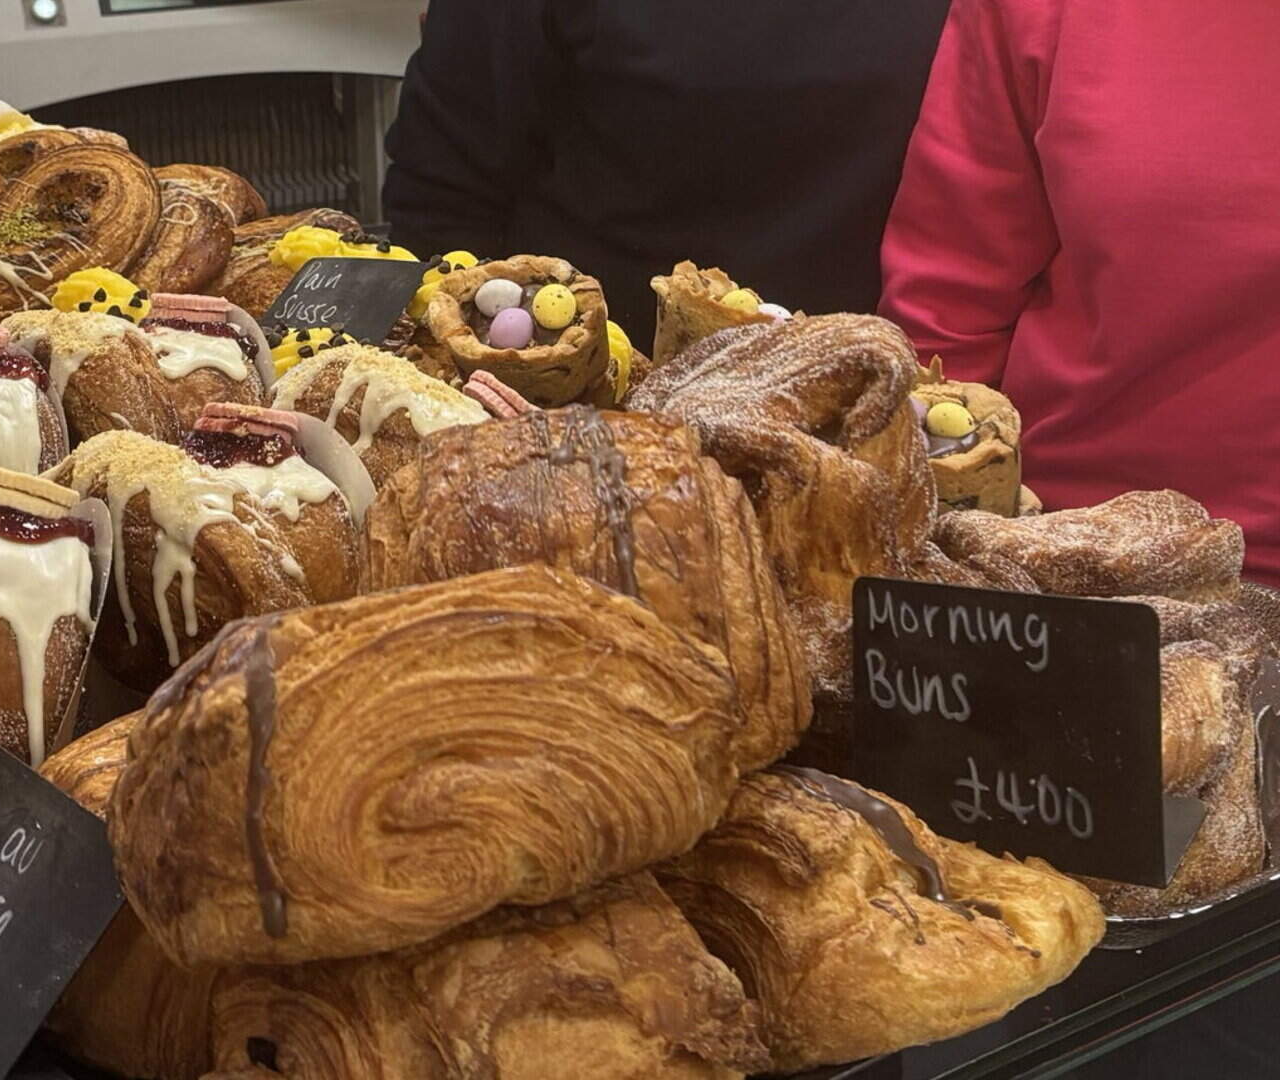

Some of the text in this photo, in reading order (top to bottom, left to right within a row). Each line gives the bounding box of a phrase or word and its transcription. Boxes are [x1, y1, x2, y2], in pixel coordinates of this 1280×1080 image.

[293, 261, 343, 293] Pain
[868, 587, 1049, 672] Morning
[865, 649, 971, 723] Buns
[0, 827, 45, 874] au
